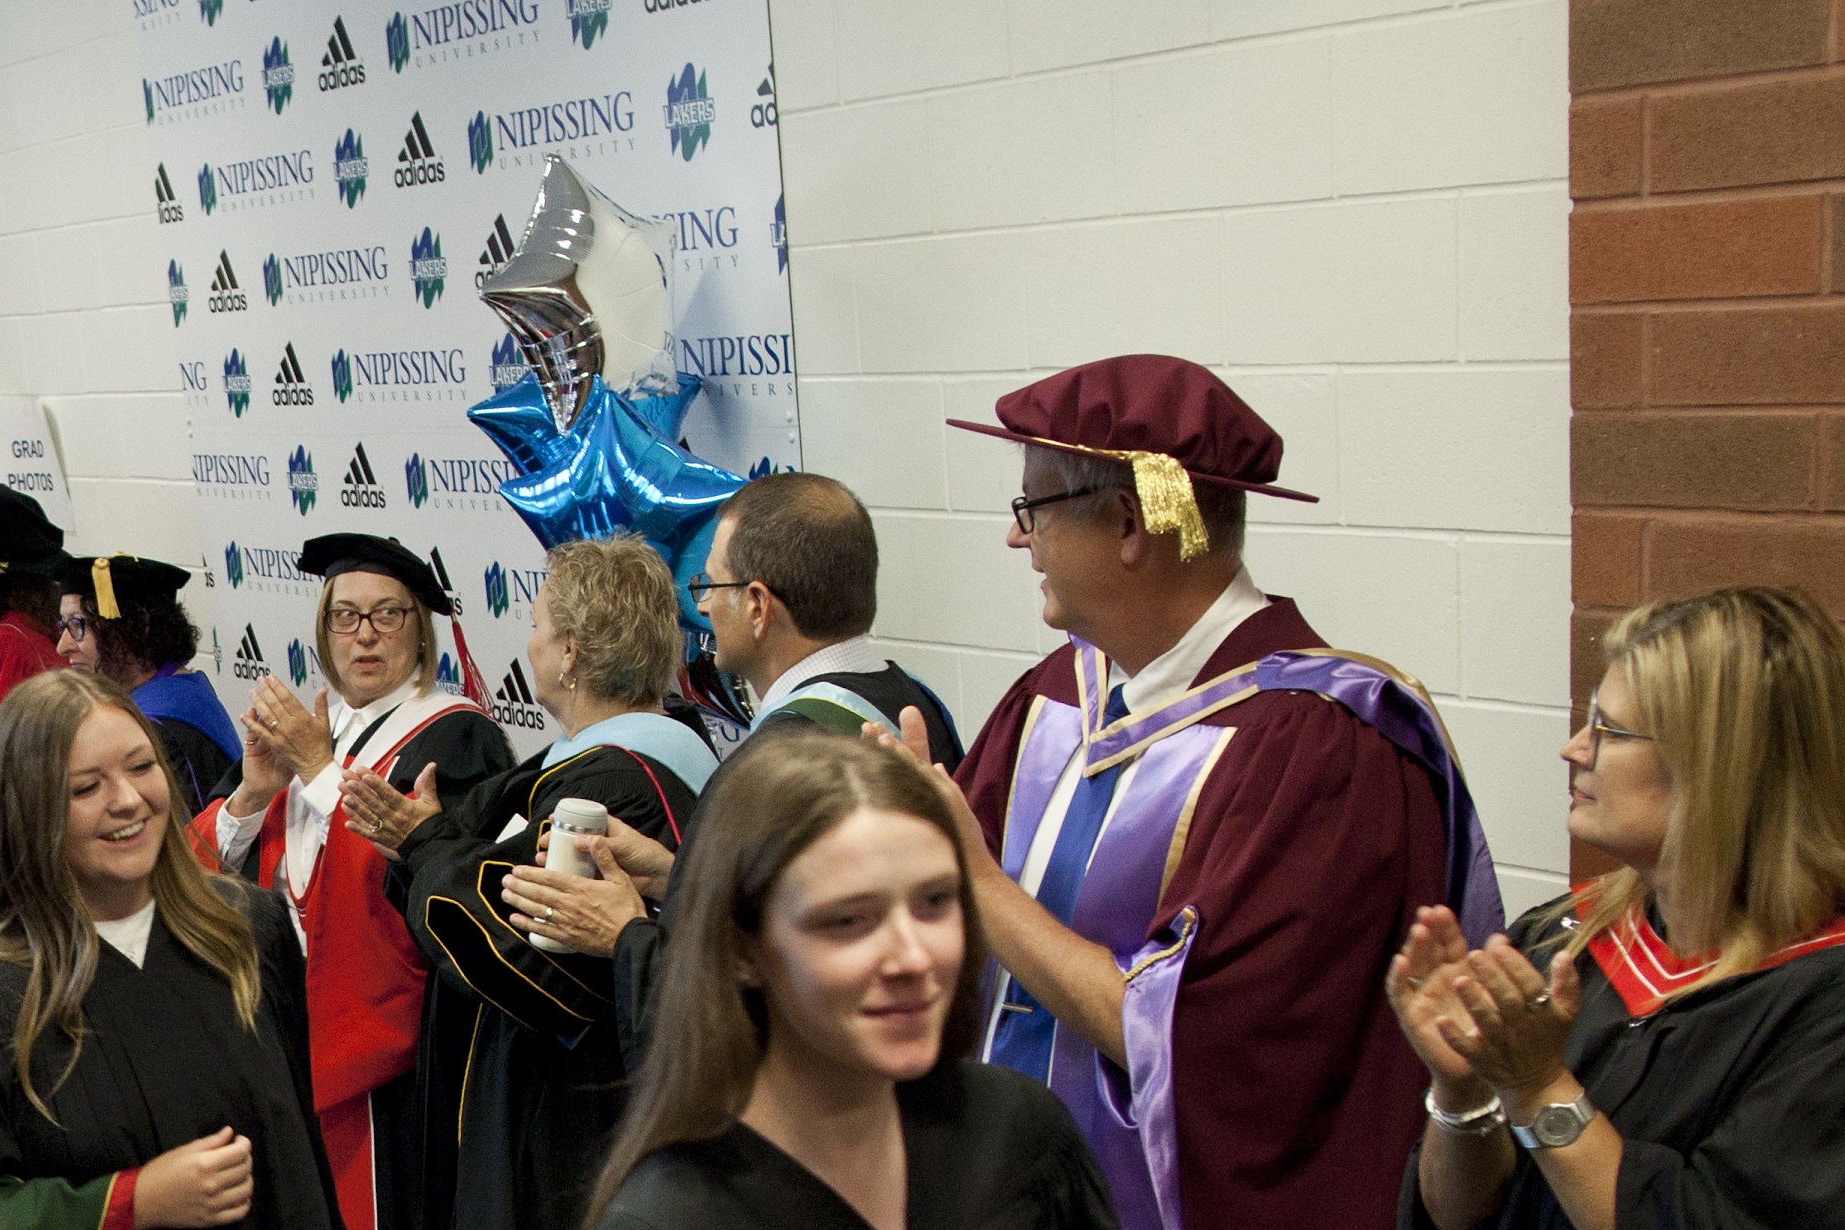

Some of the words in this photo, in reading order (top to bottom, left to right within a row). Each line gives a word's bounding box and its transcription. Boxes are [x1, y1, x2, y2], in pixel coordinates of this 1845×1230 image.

[412, 0, 539, 49] NIPISSING
[416, 29, 540, 68] UNIVERSITY
[155, 60, 245, 110] NIPISSING
[319, 61, 365, 92] adidas
[496, 91, 635, 150] NIPISSING
[663, 98, 716, 129] LAKERS
[218, 150, 314, 197] NIPISSING
[394, 160, 445, 188] adidas
[284, 246, 388, 289] NIPISSING
[409, 257, 447, 281] LAKERS
[209, 290, 248, 313] adidas
[354, 349, 467, 386] NIPISSING
[273, 384, 314, 406] adidas
[357, 389, 468, 403] UNIVERSITY
[12, 440, 44, 458] GRAD
[8, 473, 54, 491] PHOTOS
[341, 486, 386, 509] adidas
[492, 700, 545, 730] adidas
